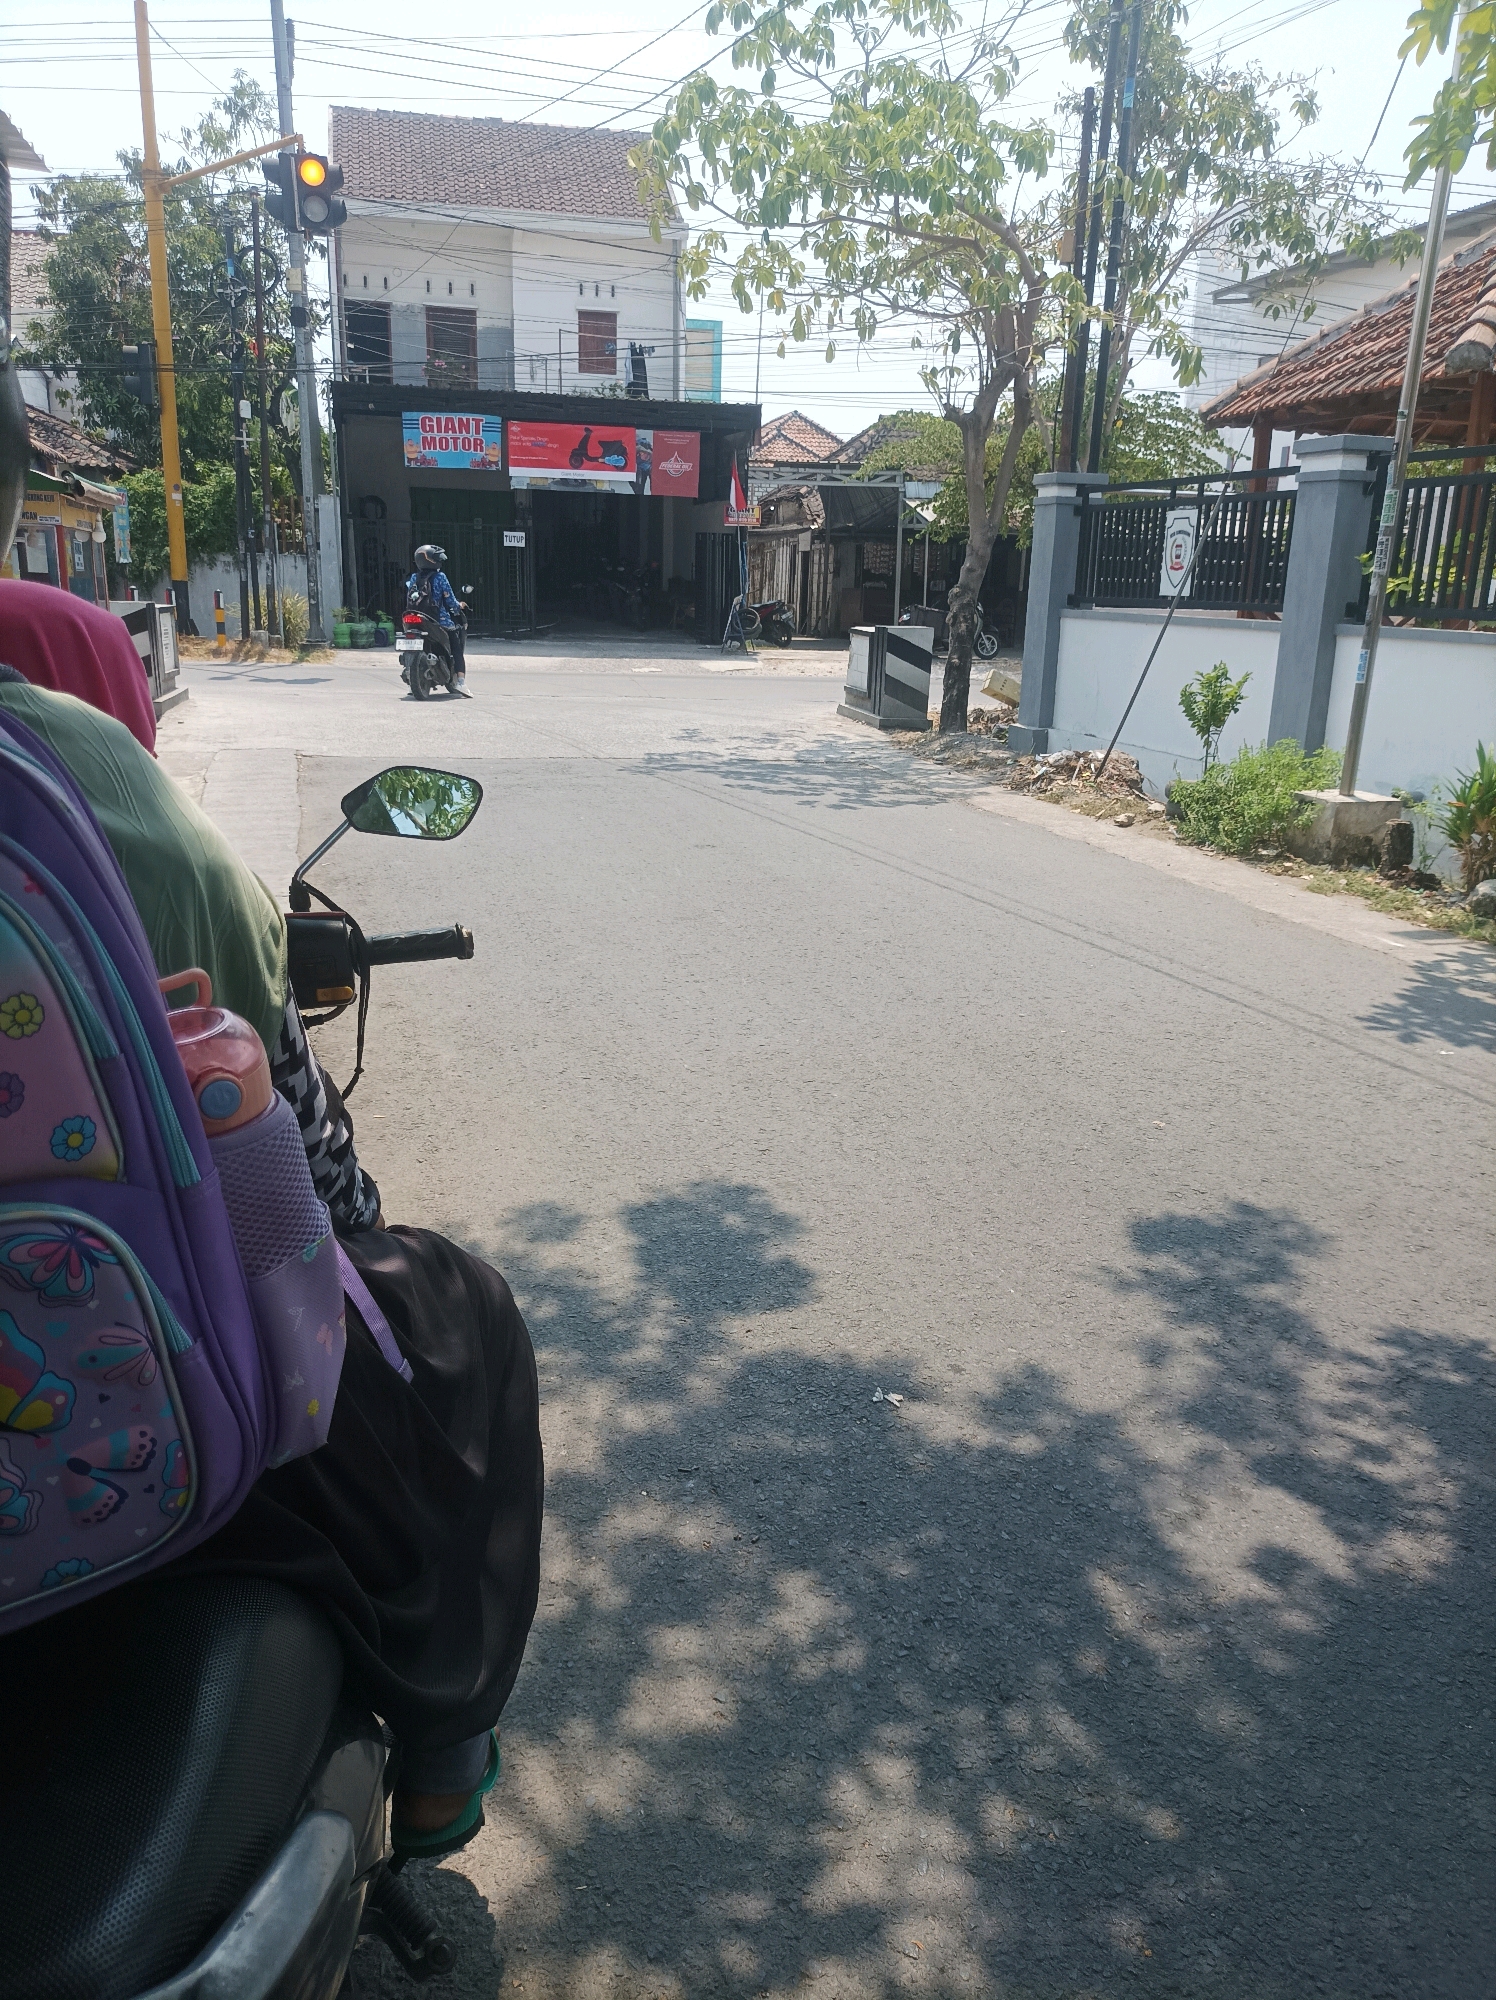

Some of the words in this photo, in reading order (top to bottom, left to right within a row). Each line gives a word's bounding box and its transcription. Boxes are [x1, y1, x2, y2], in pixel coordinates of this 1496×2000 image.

[420, 415, 485, 435] GIANT
[421, 435, 485, 453] MOTOR
[505, 535, 525, 543] TUTUP
